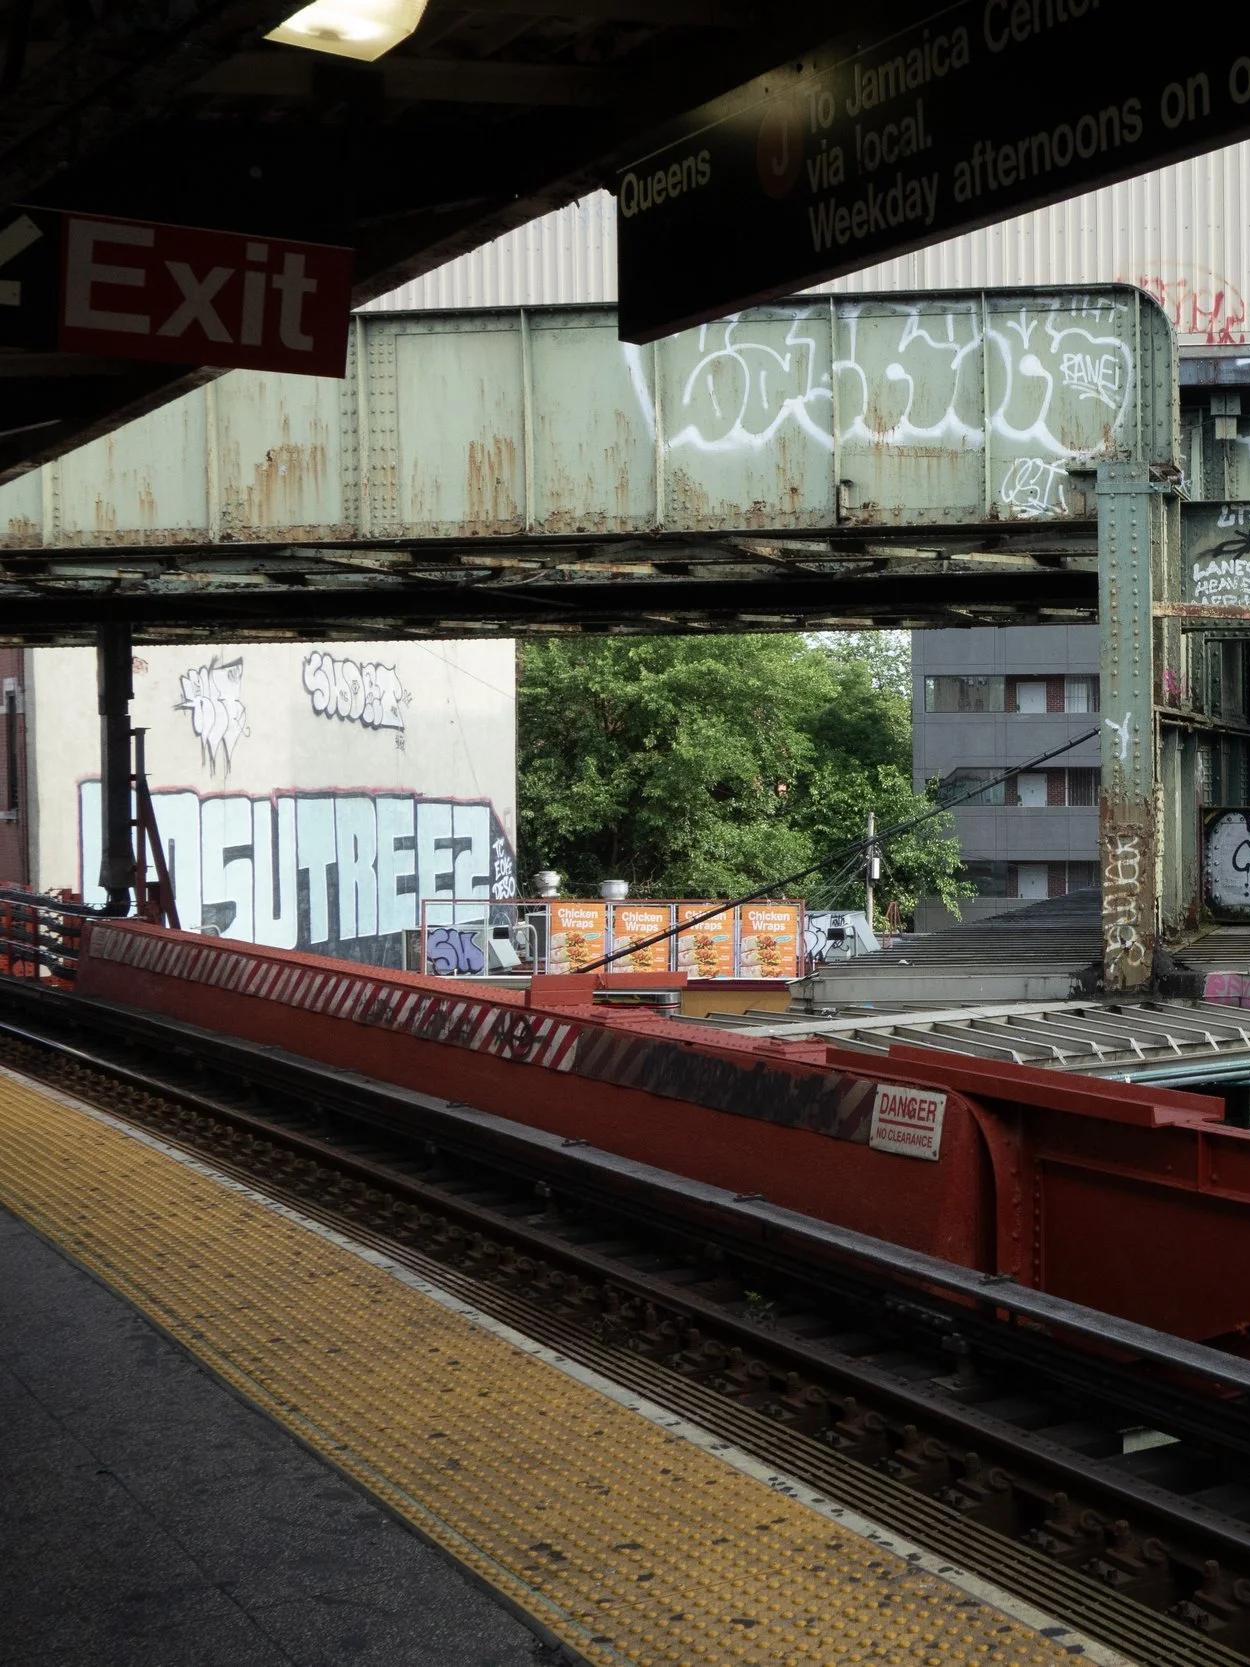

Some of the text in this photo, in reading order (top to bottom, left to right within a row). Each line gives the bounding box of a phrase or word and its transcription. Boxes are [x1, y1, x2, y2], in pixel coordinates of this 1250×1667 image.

[805, 0, 1100, 134] To Jamaica Cen
[806, 98, 934, 194] via local.
[808, 171, 940, 253] Weekday
[953, 96, 1144, 202] afternoons
[1160, 70, 1210, 130] on
[620, 147, 712, 218] Queens
[64, 217, 319, 352] Exit
[557, 908, 599, 919] Chicken
[561, 918, 594, 929] Wraps
[621, 911, 663, 922] Chicken
[748, 910, 790, 921] Chicken
[625, 921, 659, 932] Wraps
[752, 920, 786, 931] Wraps
[879, 1092, 938, 1123] DANGER
[876, 1127, 934, 1149] NO CLEARANCE
